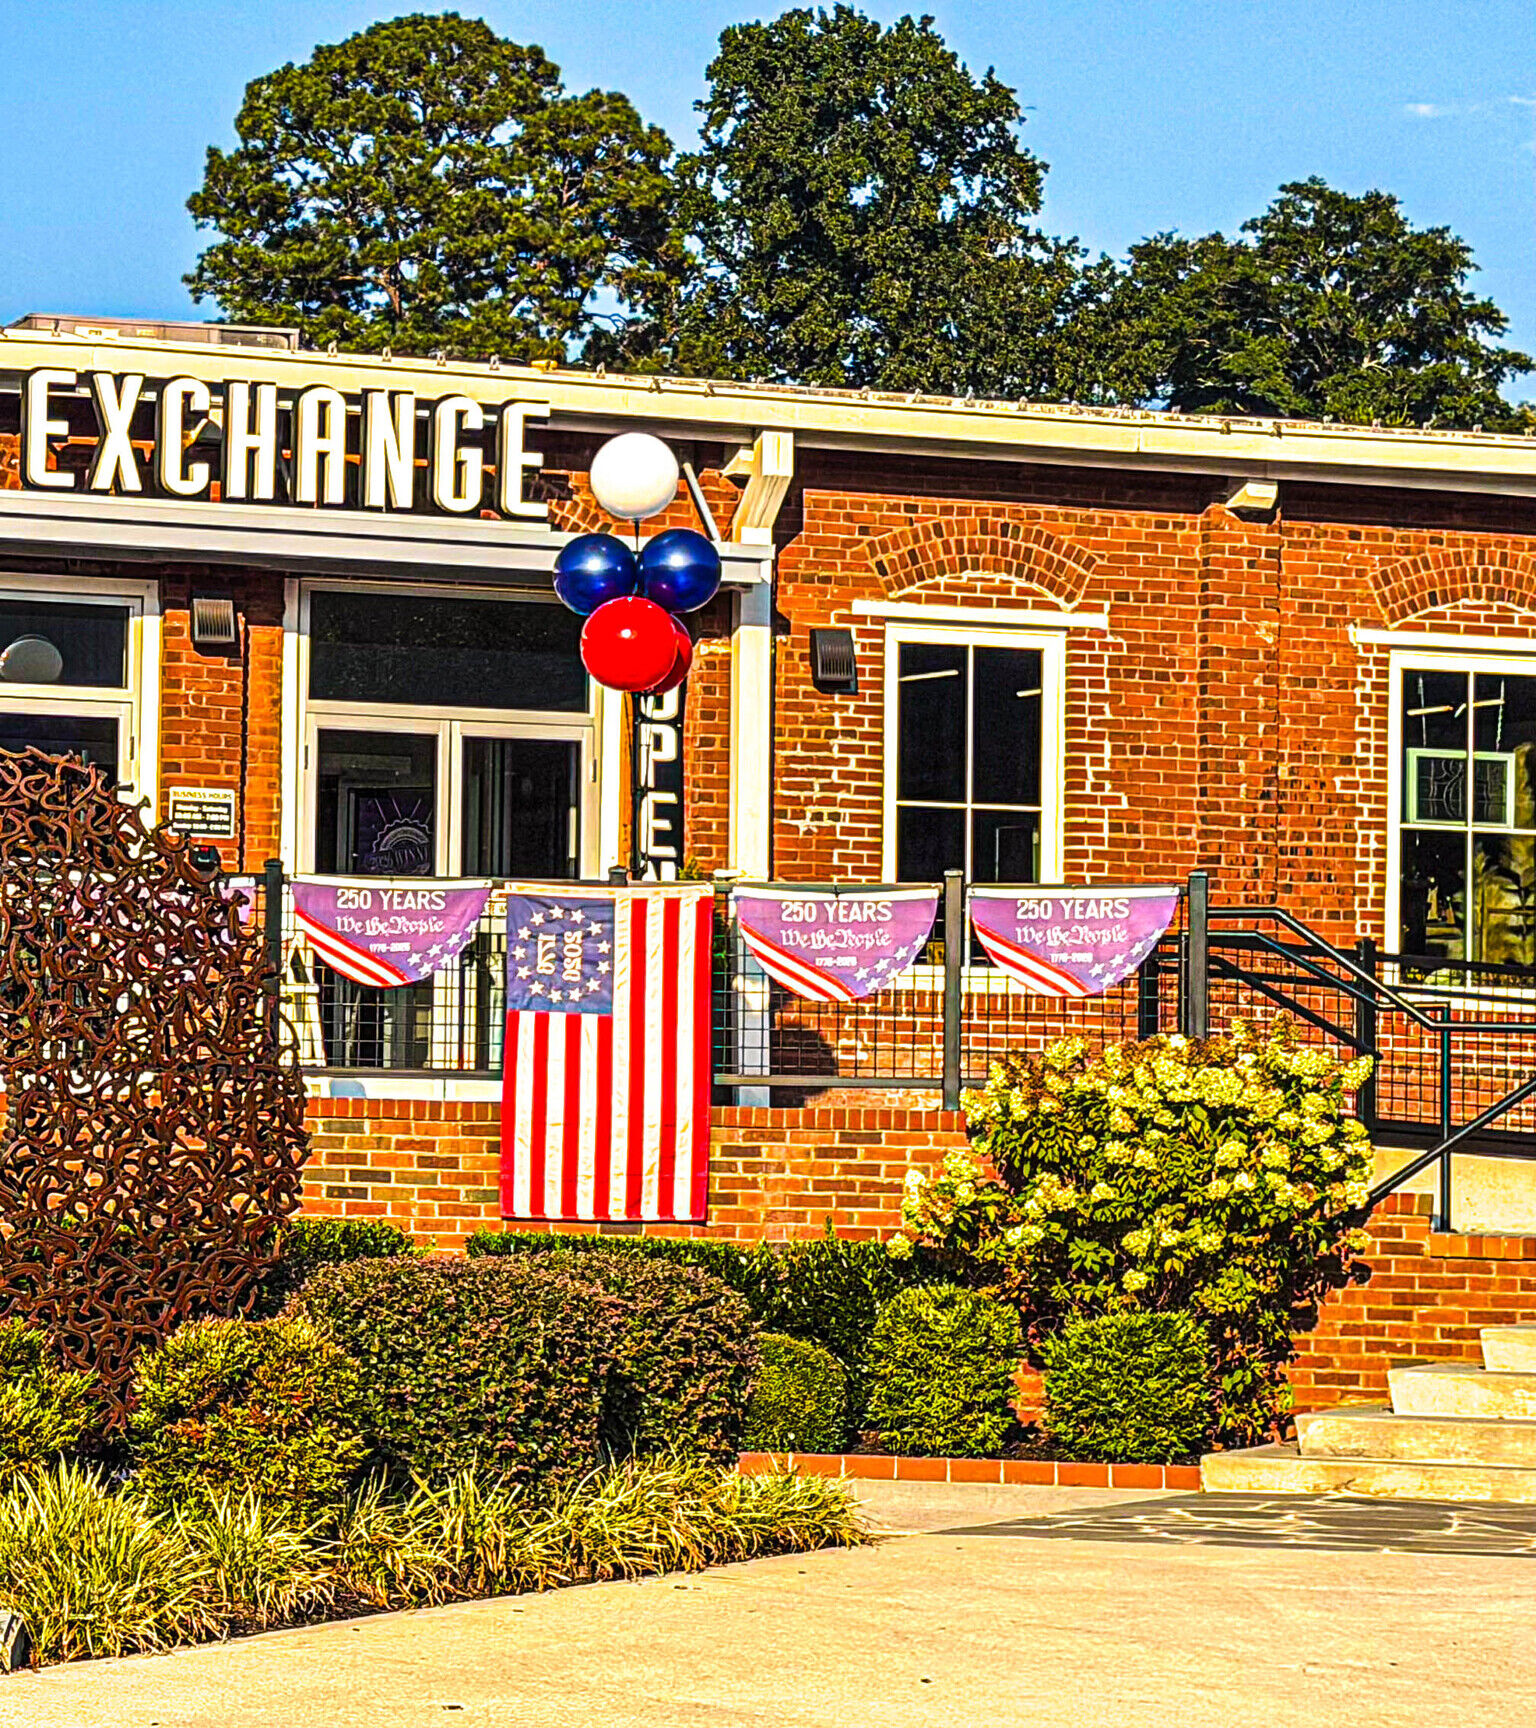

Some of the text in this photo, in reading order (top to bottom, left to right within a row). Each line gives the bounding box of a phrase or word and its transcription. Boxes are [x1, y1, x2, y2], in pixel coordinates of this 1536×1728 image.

[26, 368, 551, 518] EXCHANGE
[336, 889, 446, 911] 250 YEARS
[1016, 899, 1130, 920] 250 YEARS
[781, 901, 893, 923] 250 YEARS
[335, 915, 445, 936] We the People
[1015, 924, 1129, 947] We the People
[780, 928, 892, 950] We the People
